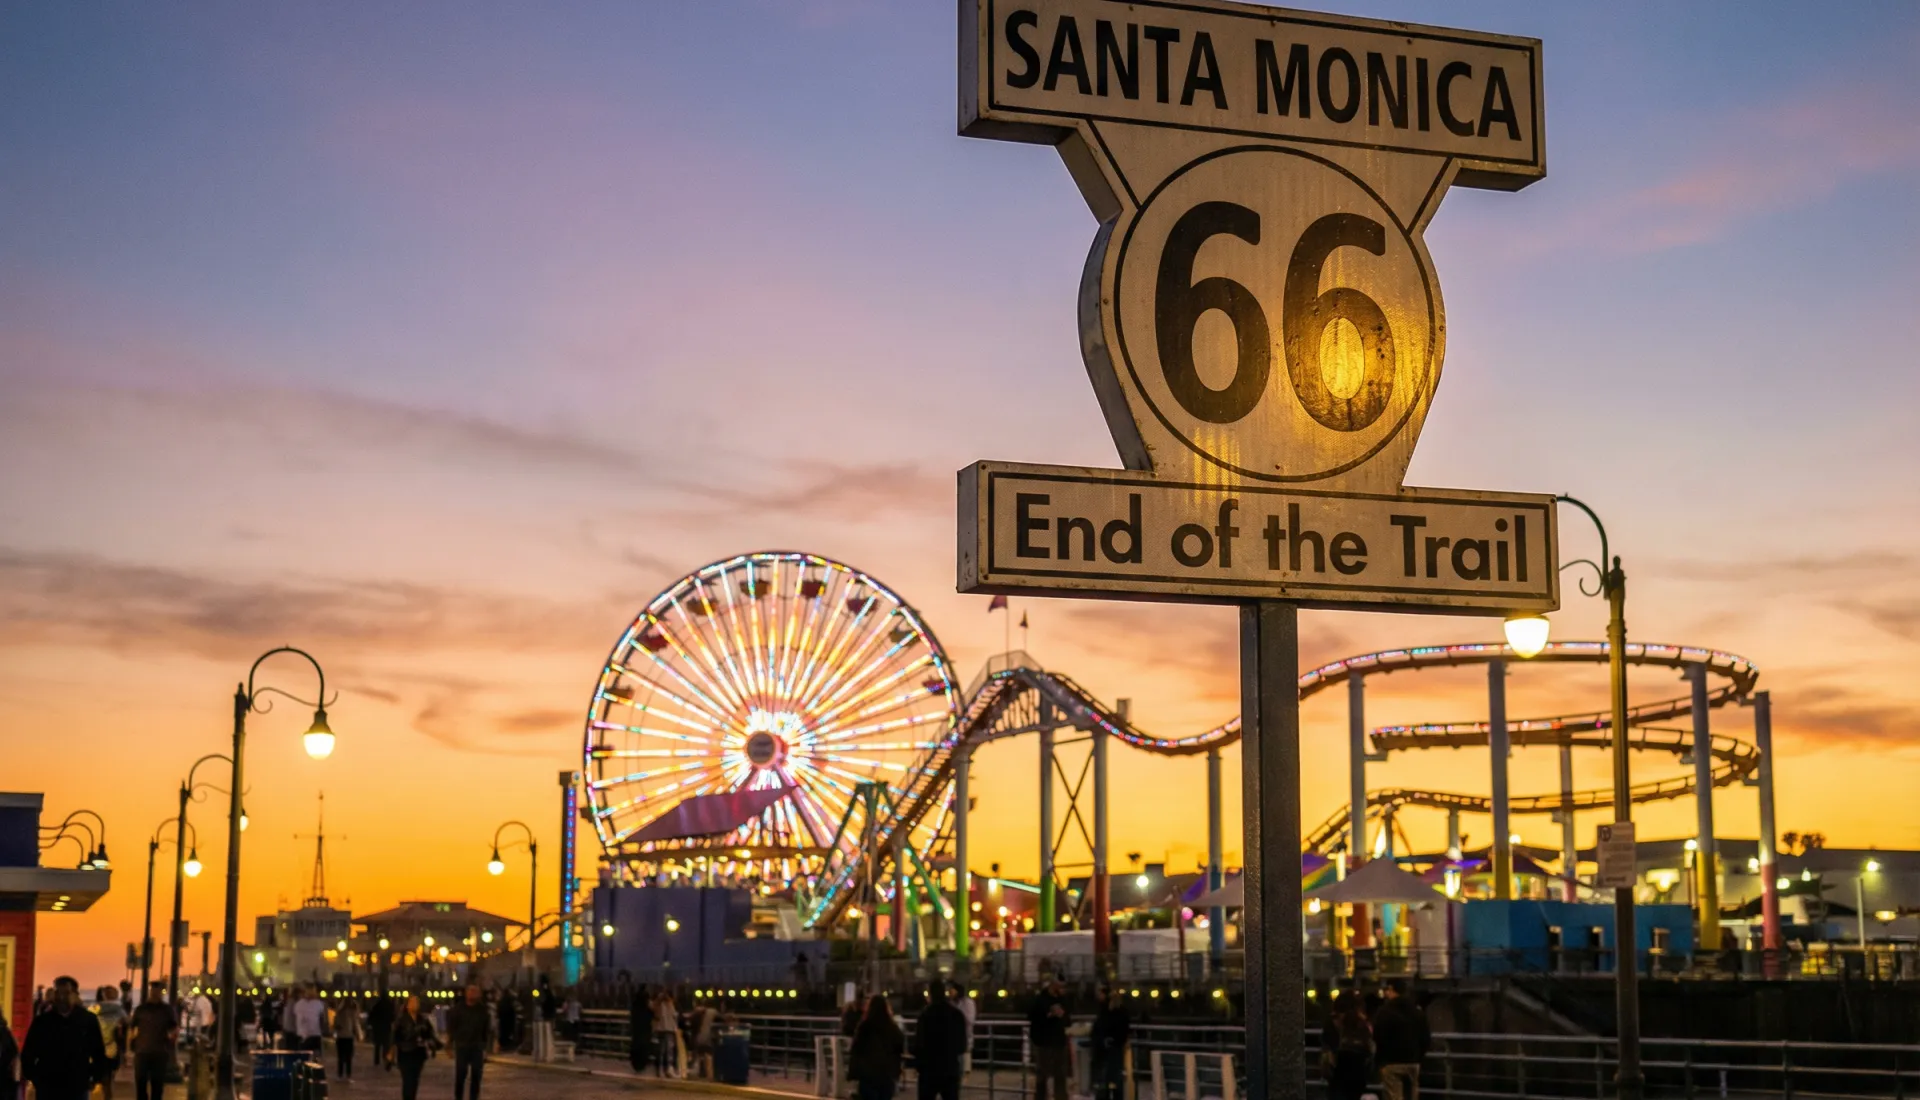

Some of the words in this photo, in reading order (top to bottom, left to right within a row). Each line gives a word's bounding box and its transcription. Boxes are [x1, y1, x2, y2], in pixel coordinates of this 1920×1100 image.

[1005, 10, 1228, 110] SANTA
[1255, 39, 1522, 141] MONICA
[1155, 201, 1395, 432] 66
[1016, 493, 1142, 564] End
[1171, 500, 1239, 568] of
[1263, 503, 1368, 575] the
[1390, 514, 1527, 583] Trail
